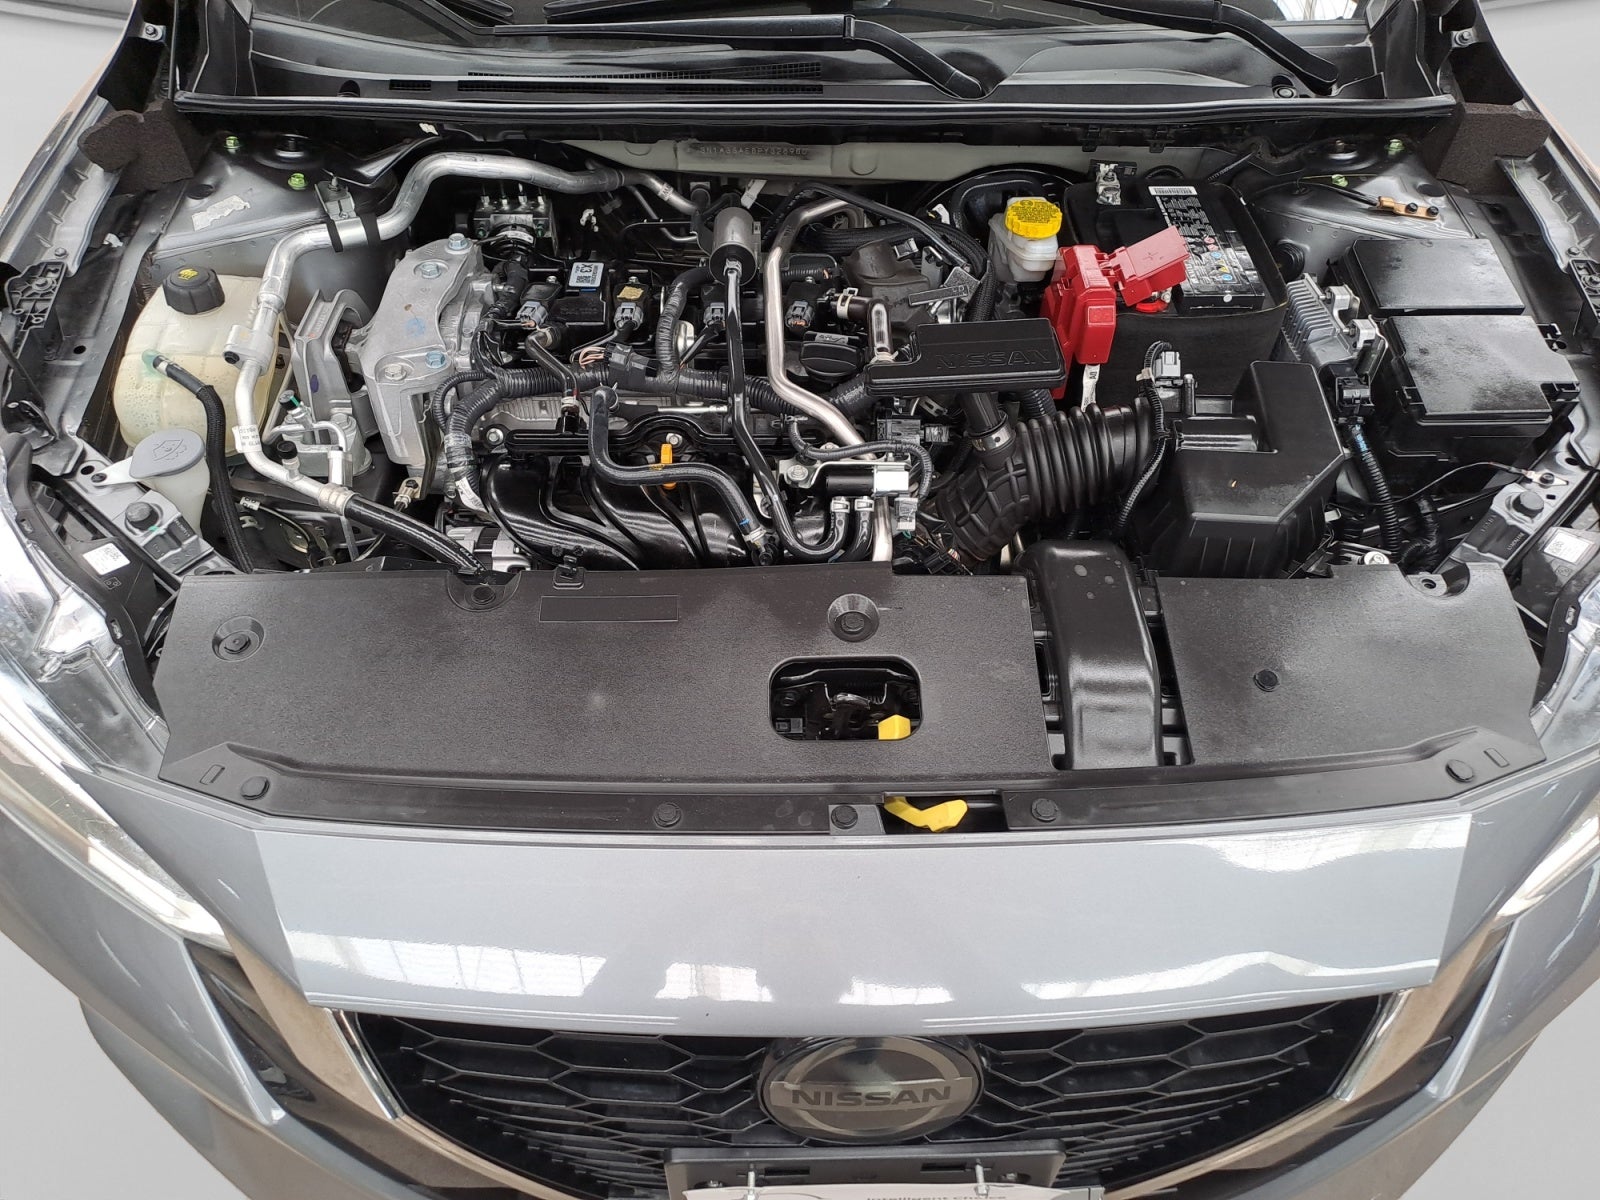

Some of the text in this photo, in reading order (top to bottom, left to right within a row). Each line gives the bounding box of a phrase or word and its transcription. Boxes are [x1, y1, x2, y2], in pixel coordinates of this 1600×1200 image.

[579, 263, 594, 273] X3
[935, 350, 1052, 369] NISSAN
[791, 1086, 952, 1107] NISSAN
